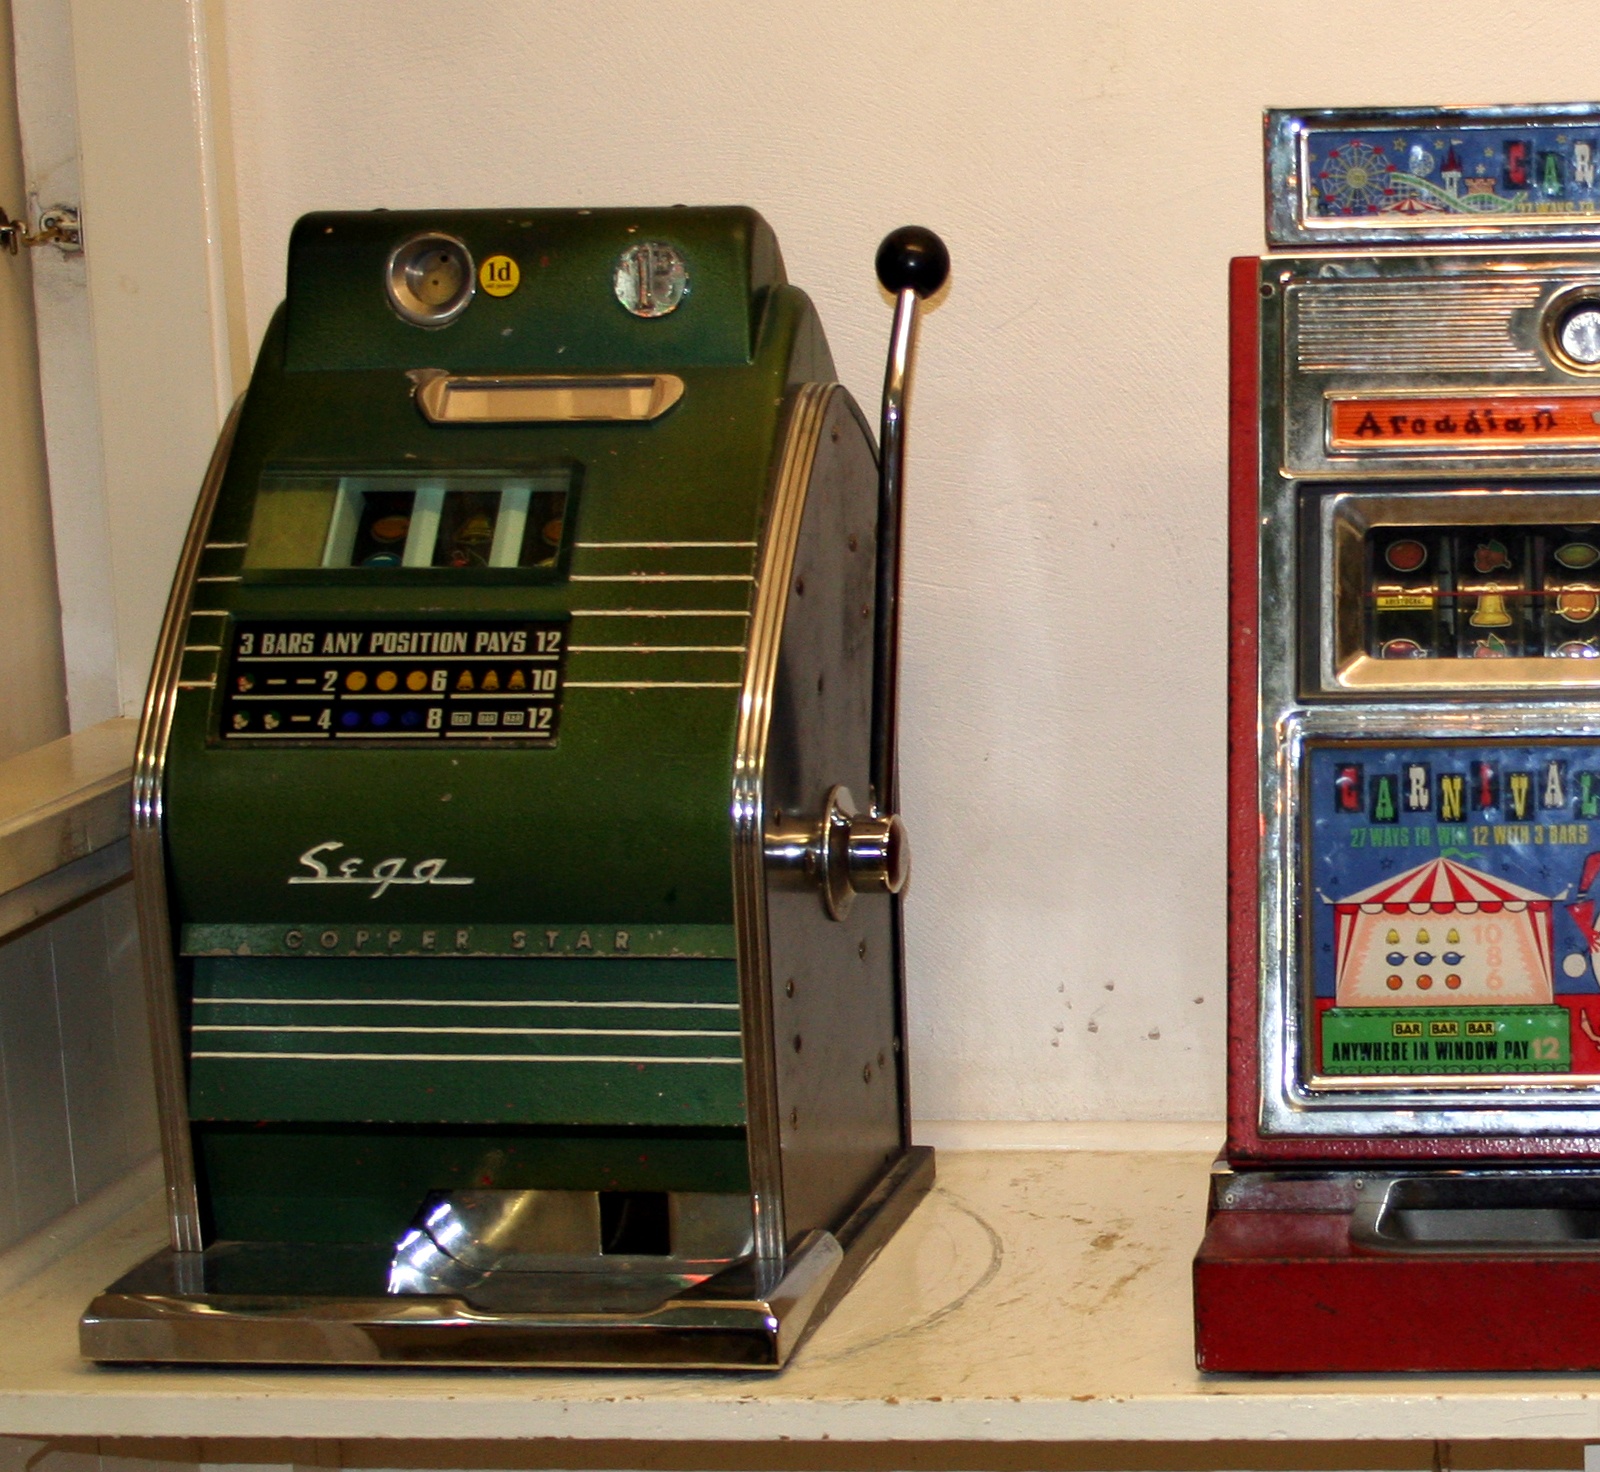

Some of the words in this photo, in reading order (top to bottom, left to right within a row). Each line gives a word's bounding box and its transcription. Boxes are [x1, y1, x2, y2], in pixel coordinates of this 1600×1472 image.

[489, 261, 511, 281] 1d
[1354, 409, 1558, 437] Arcadian
[239, 633, 254, 654] 3
[261, 633, 314, 654] BARS
[322, 632, 363, 654] ANY
[370, 632, 468, 653] POSITION
[474, 631, 527, 653] PAYS
[535, 631, 562, 652] 12
[322, 671, 338, 692] 2
[431, 670, 447, 691] 6
[531, 669, 557, 691] 10
[317, 708, 332, 729] 4
[426, 708, 442, 729] 8
[528, 707, 553, 728] 12
[1339, 761, 1600, 821] CARNIVAL
[1351, 828, 1366, 847] 27
[1370, 827, 1409, 847] WAYS
[1415, 827, 1430, 846] TO
[1436, 826, 1468, 846] WIN
[1472, 826, 1489, 845] 12
[1493, 825, 1530, 845] WITH
[1534, 825, 1544, 845] 3
[1548, 824, 1588, 844] BARS
[289, 841, 469, 898] Sega
[285, 929, 471, 952] COPPER
[510, 929, 632, 951] STAR
[1473, 924, 1503, 944] 10
[1486, 946, 1502, 967] 8
[1486, 970, 1503, 990] 6
[1394, 1023, 1421, 1035] BAR
[1430, 1022, 1458, 1035] BAR
[1467, 1022, 1495, 1035] BAR
[1332, 1042, 1408, 1061] ANYWHERE
[1414, 1042, 1429, 1061] IN
[1435, 1041, 1498, 1061] WINDOW
[1504, 1040, 1529, 1060] PAY
[1531, 1037, 1560, 1060] 12
